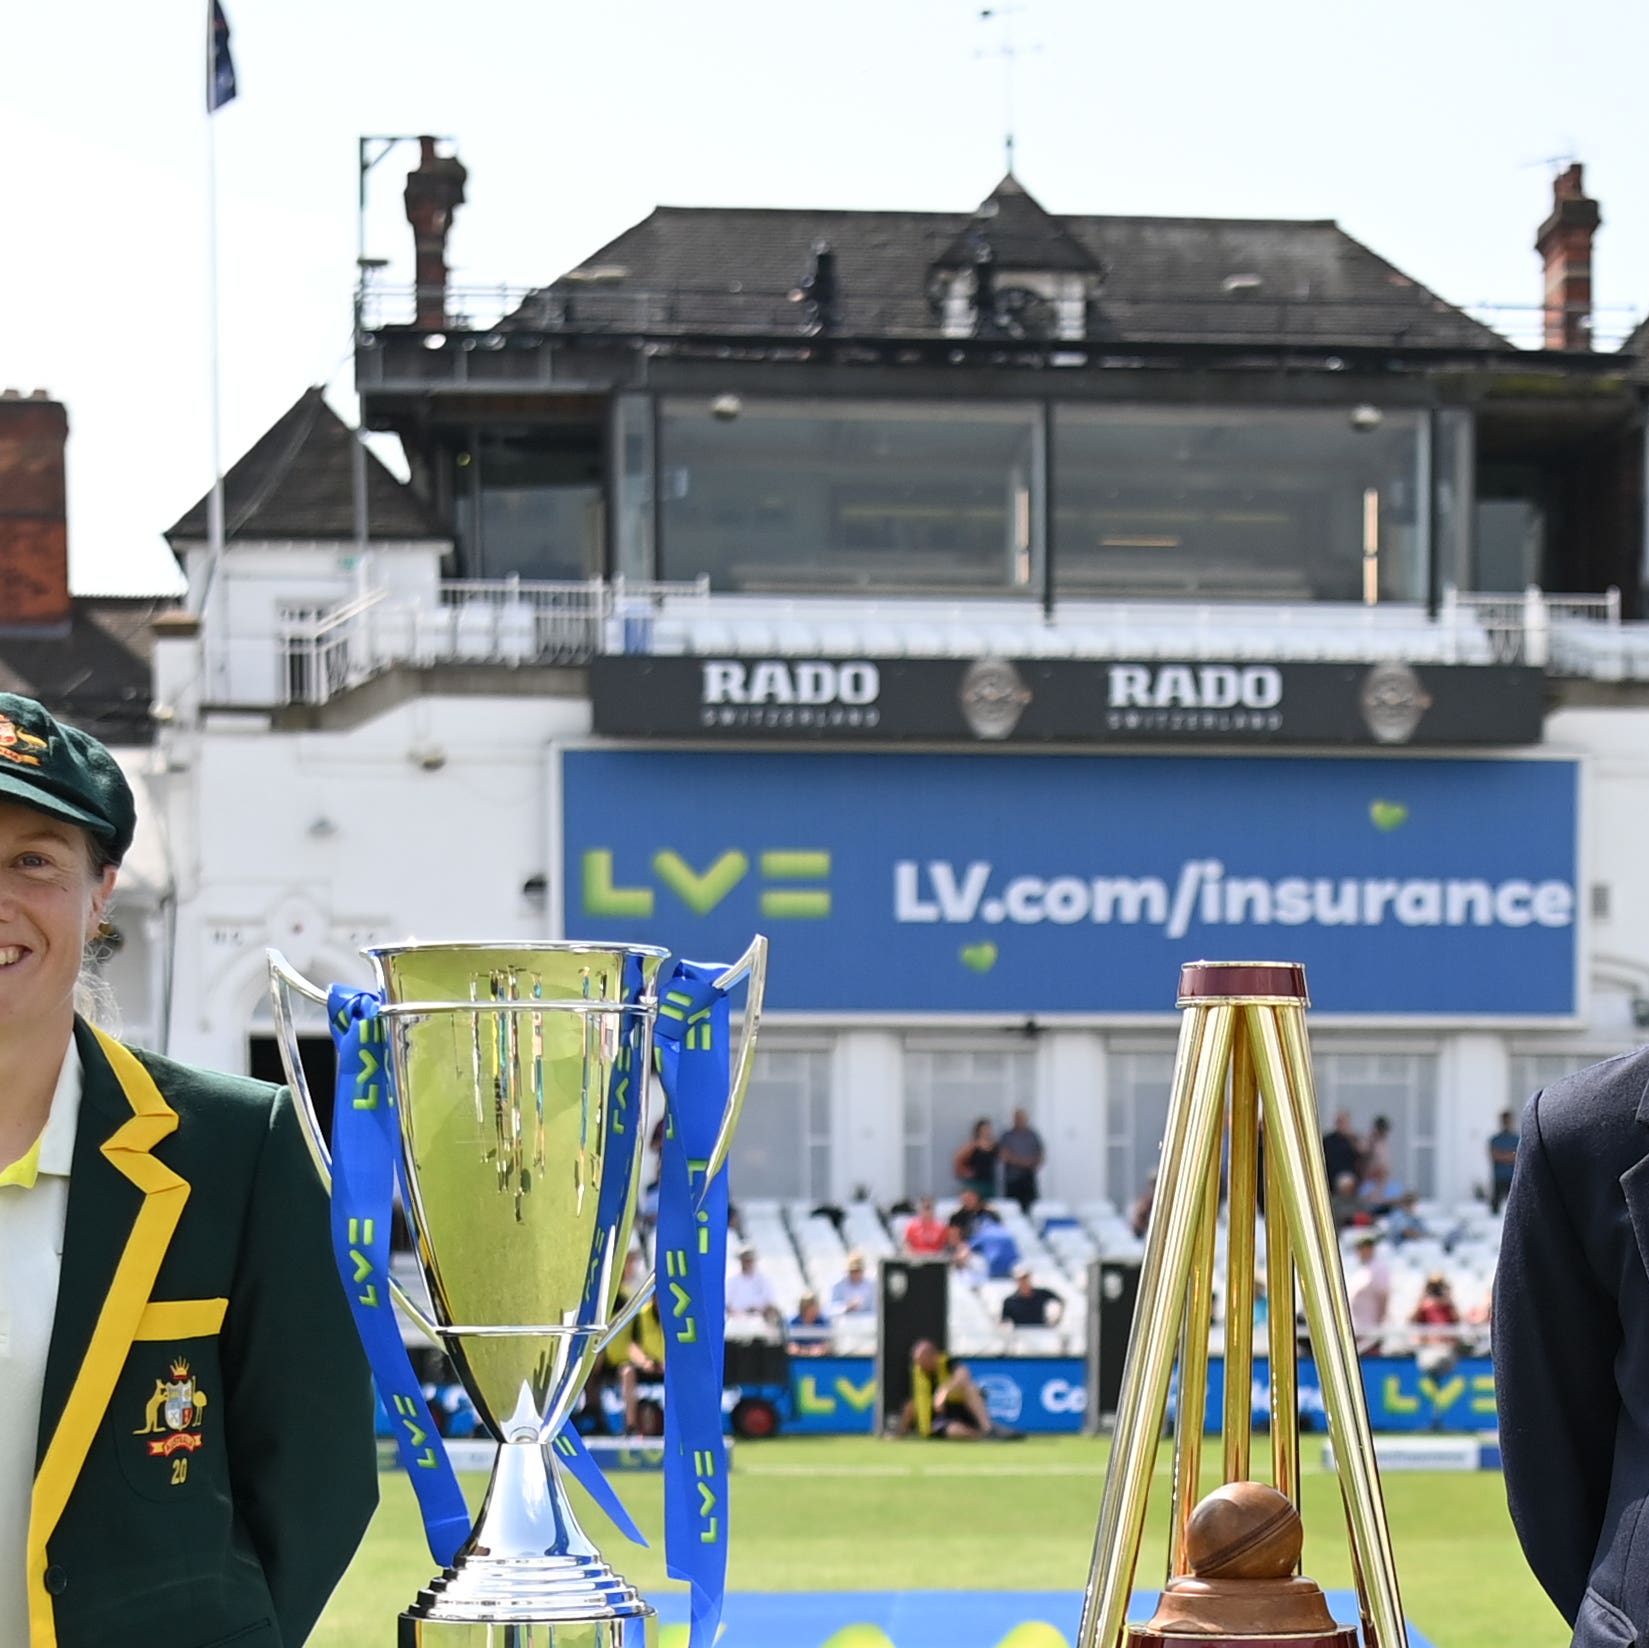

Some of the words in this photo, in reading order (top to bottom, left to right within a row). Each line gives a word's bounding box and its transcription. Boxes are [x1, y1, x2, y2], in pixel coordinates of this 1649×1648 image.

[704, 661, 880, 704] RADO
[1109, 665, 1283, 708] RADO
[702, 707, 881, 728] SWITZERLAND
[1108, 710, 1283, 731] SWITZERLAND
[895, 859, 1575, 938] LV.com/insurance
[171, 1458, 188, 1485] 20
